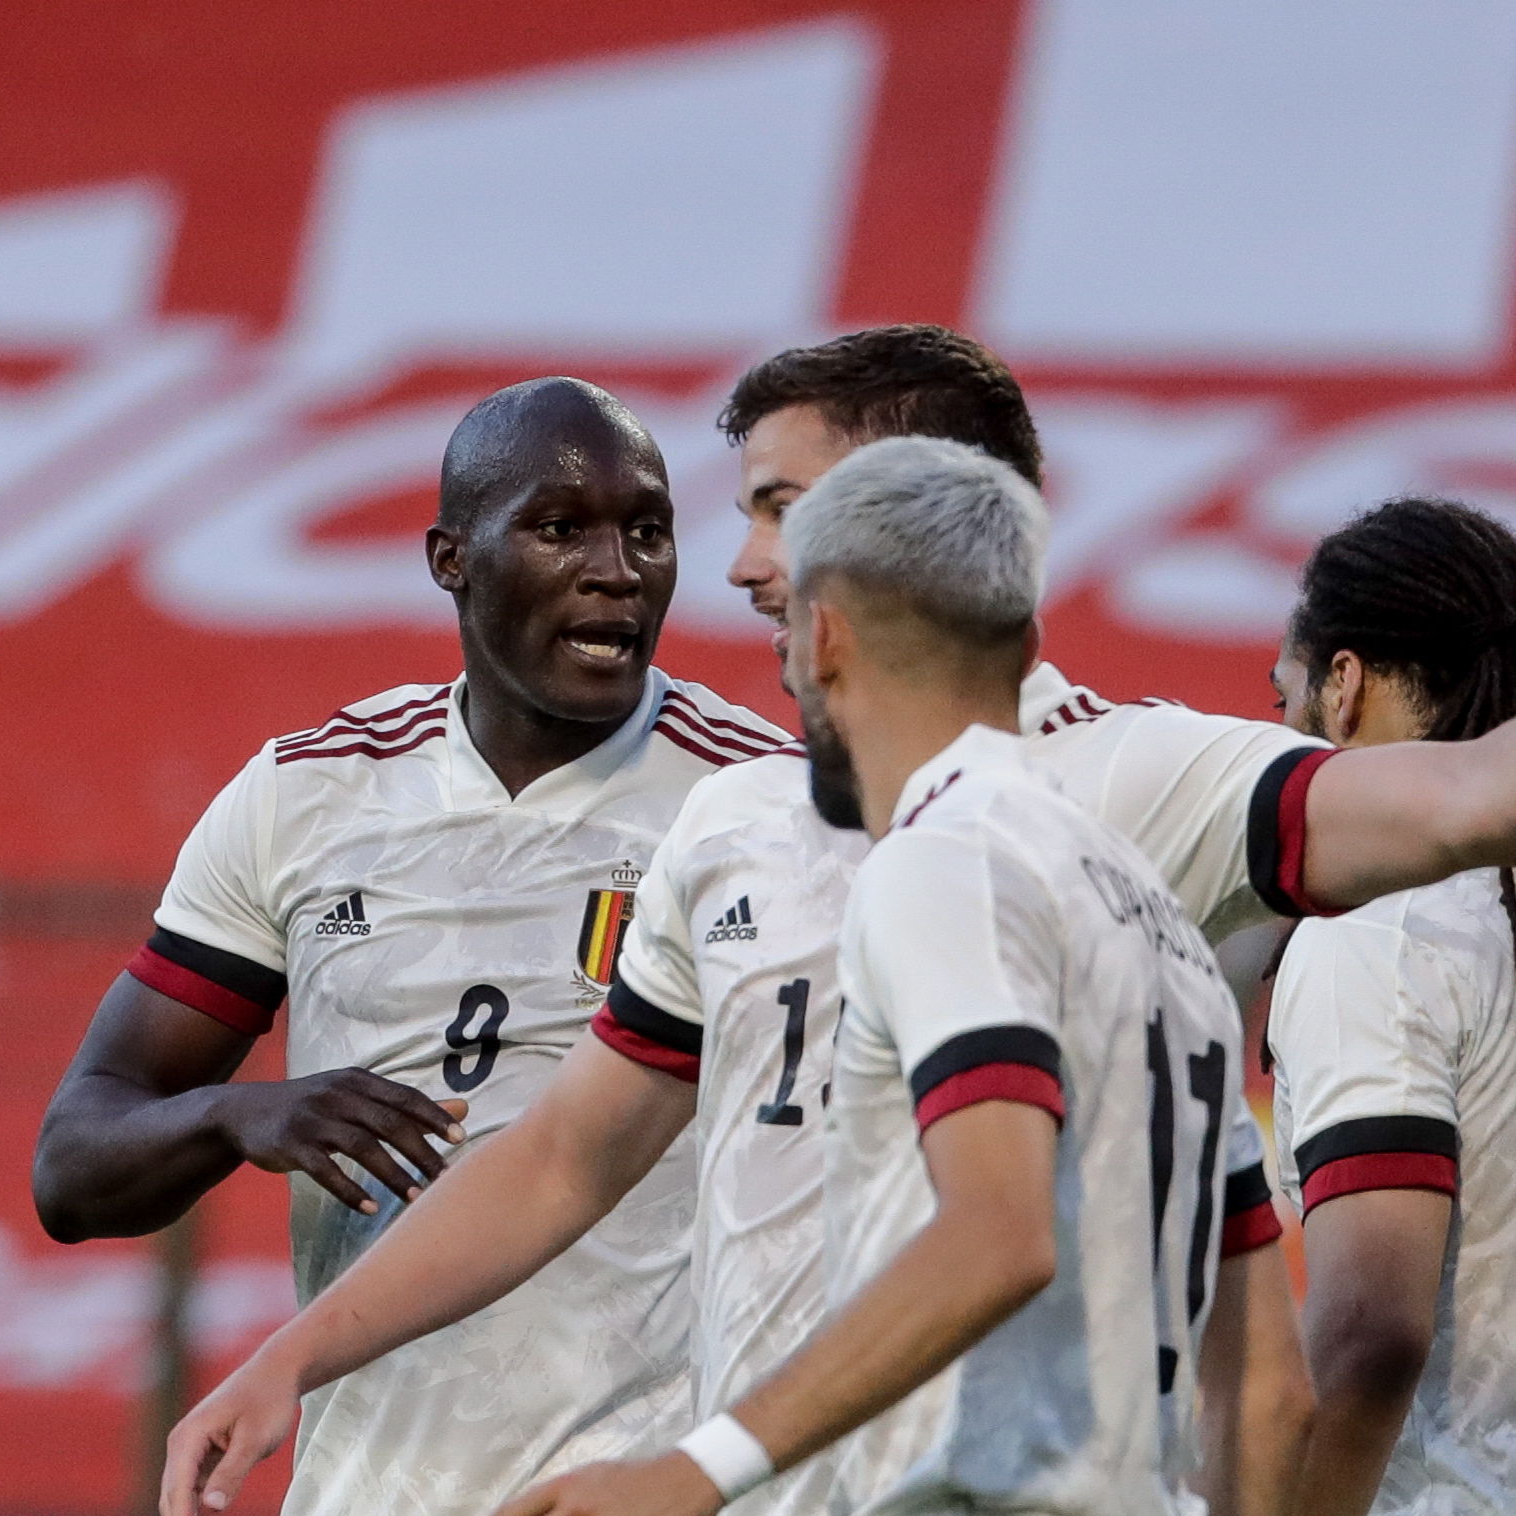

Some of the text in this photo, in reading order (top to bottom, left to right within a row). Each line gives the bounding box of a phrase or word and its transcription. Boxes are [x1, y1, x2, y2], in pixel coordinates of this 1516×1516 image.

[315, 917, 372, 936] adidas
[704, 921, 758, 944] adidas
[442, 983, 510, 1093] 9
[757, 977, 846, 1125] 1
